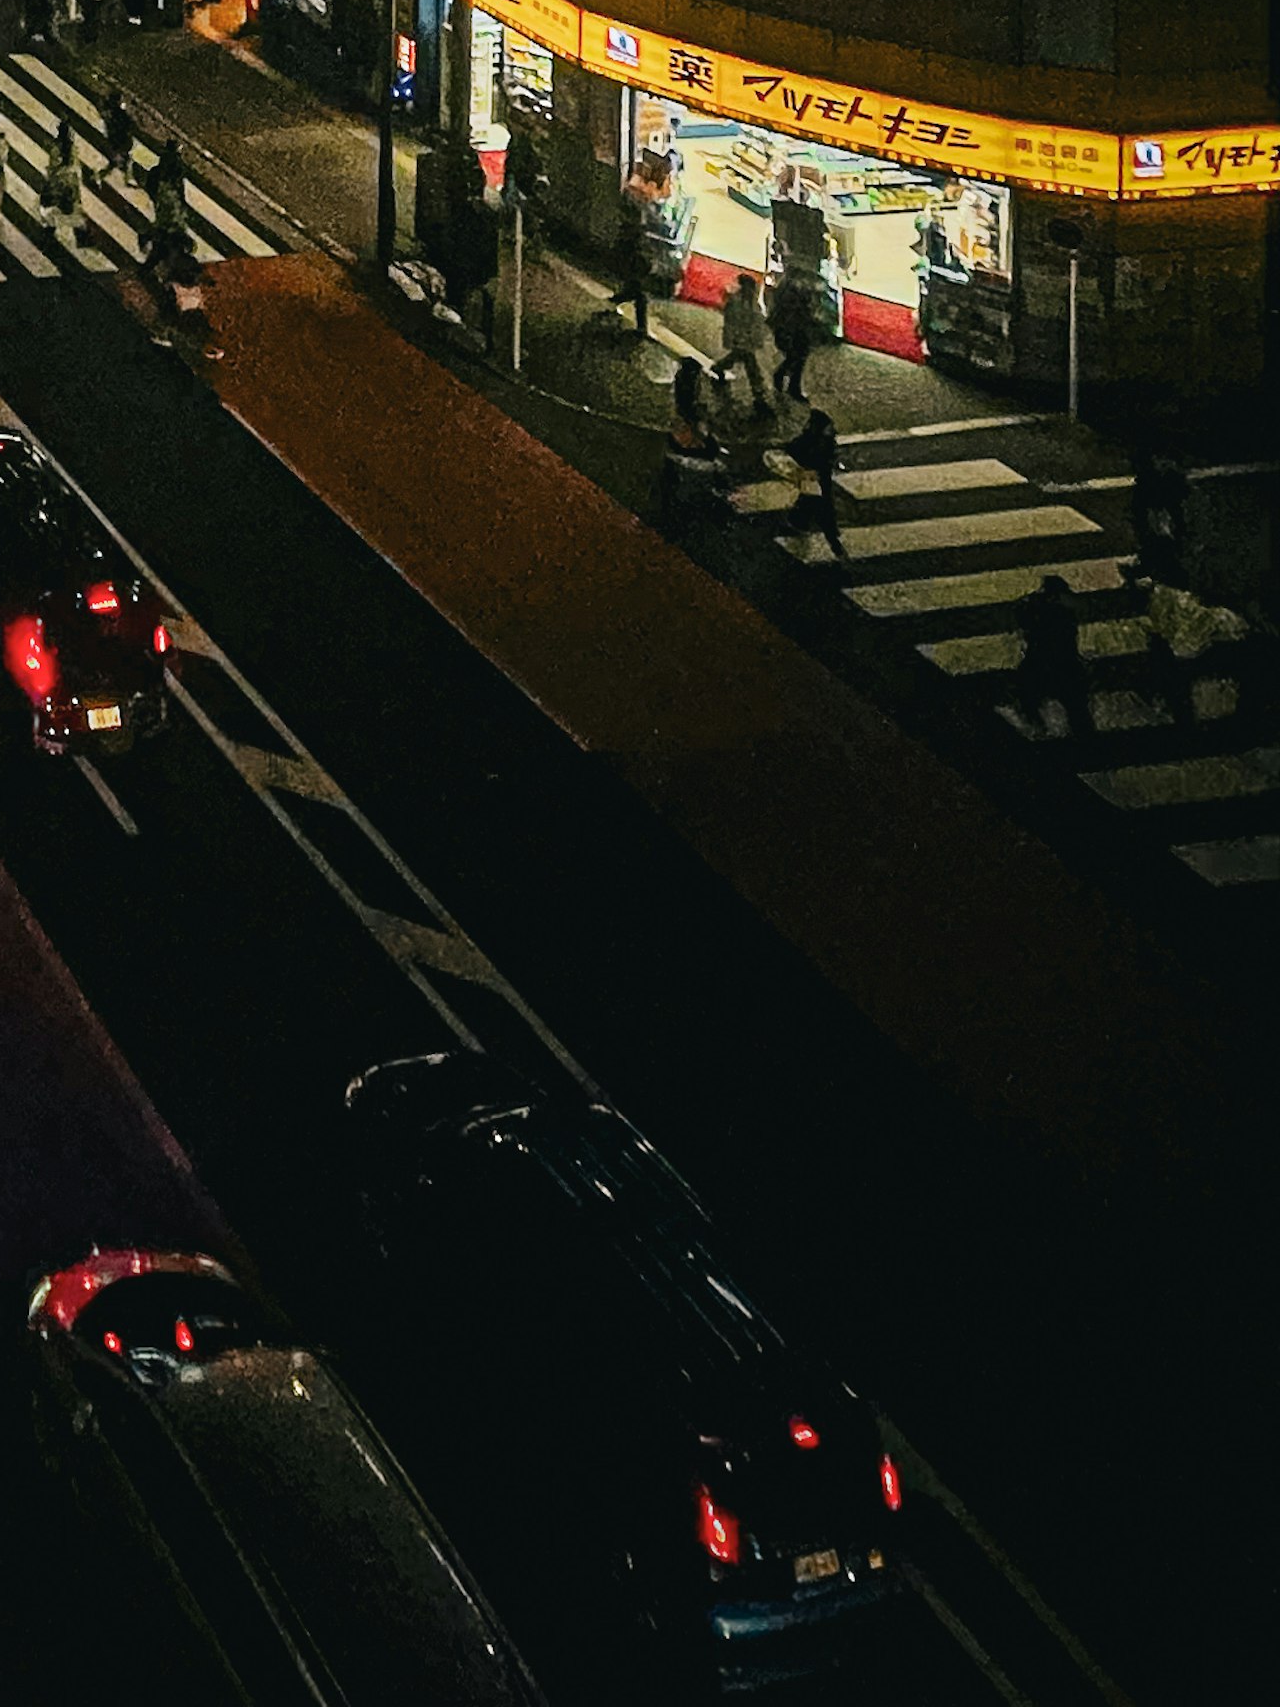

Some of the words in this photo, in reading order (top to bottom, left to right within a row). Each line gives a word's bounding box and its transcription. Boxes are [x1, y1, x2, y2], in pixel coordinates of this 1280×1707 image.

[668, 47, 715, 93] 薬
[742, 73, 981, 150] マツモトキヨシ
